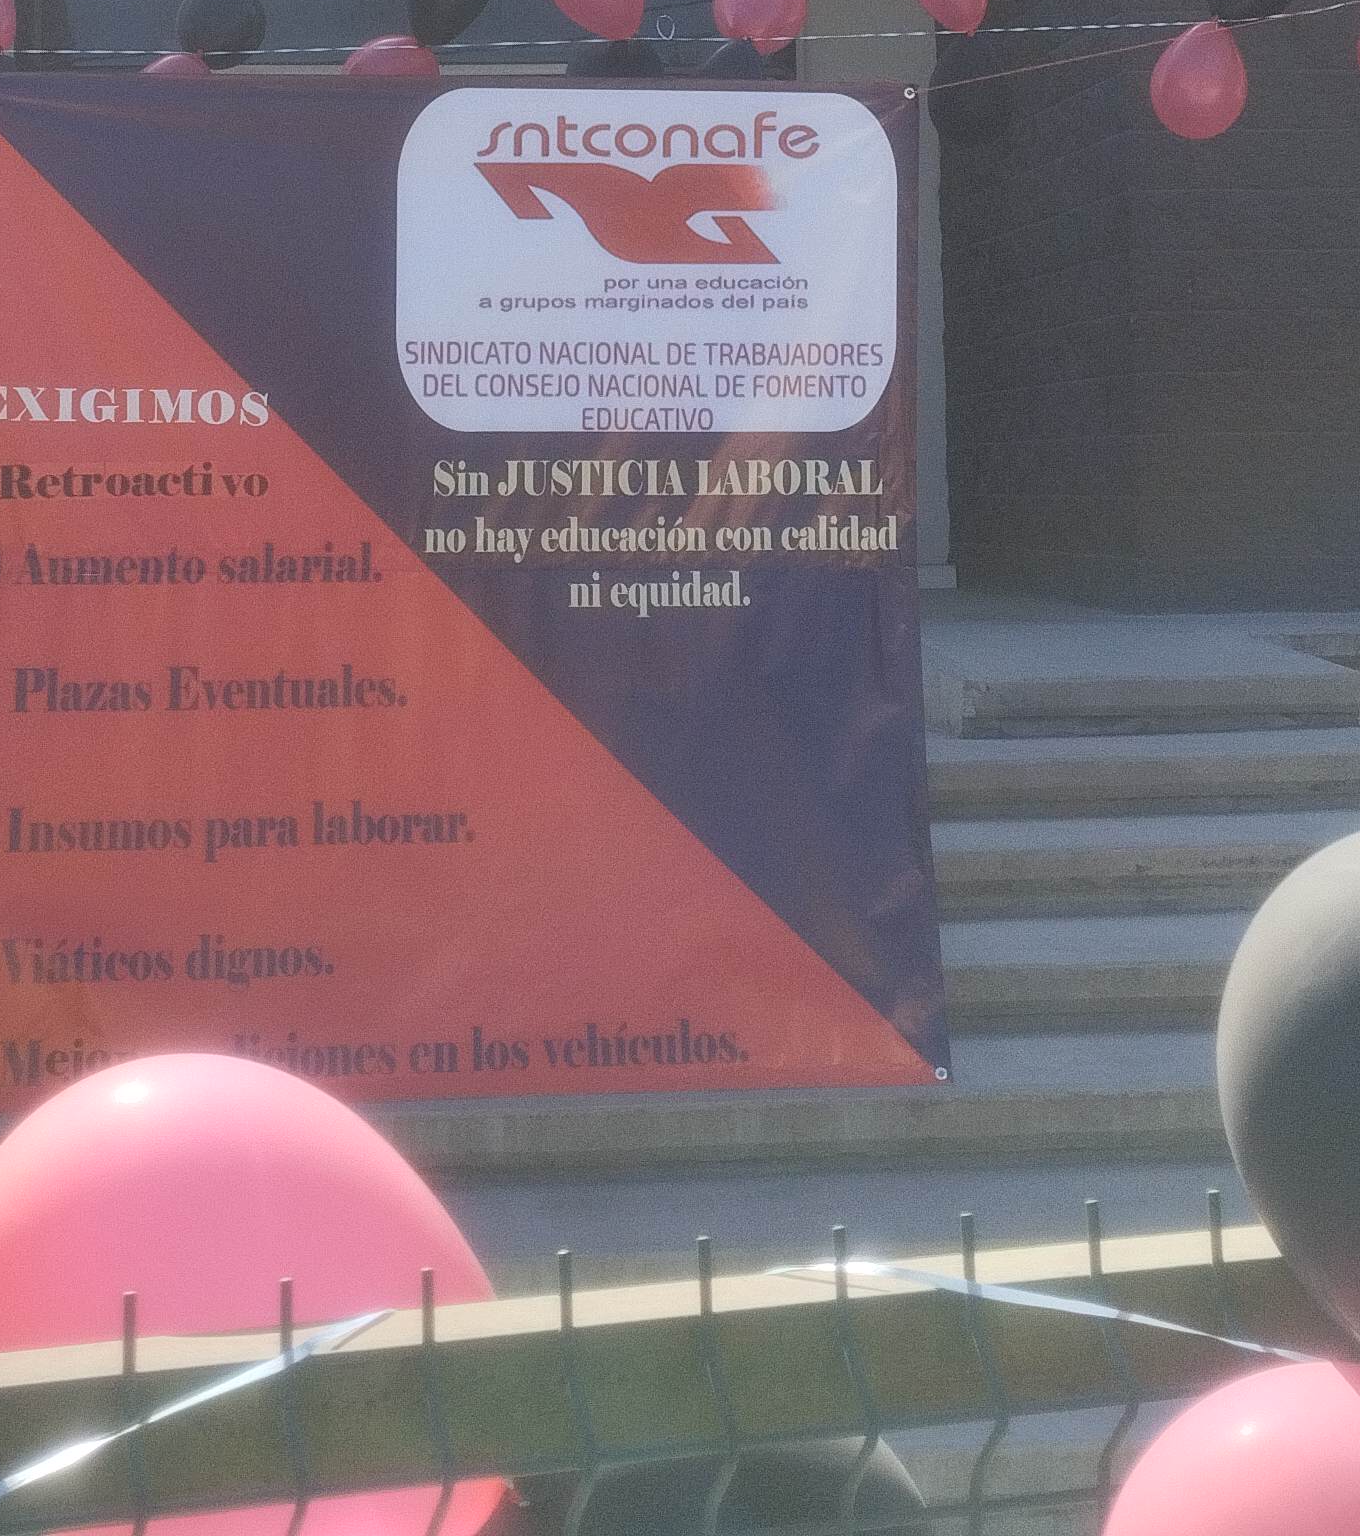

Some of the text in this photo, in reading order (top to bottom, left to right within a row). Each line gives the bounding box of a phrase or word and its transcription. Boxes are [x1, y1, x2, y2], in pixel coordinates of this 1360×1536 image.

[477, 110, 821, 159] sntconafe
[478, 293, 809, 313] a grupos marginados del país
[603, 274, 809, 293] por una educación
[405, 341, 884, 367] SINDICATO NACIONAL DE TRABAJADORES
[422, 373, 866, 399] DEL CONSEJO NACIONAL DE FOMENTO
[581, 407, 714, 432] EDUCATIVO
[433, 459, 883, 498] Sin JUSTICIA LABORAL
[425, 514, 899, 564] no hay educación con calidad
[13, 541, 383, 586] Aumento salarial.
[568, 570, 752, 617] ni equidad.
[9, 663, 408, 713] Plazas Eventuales.
[4, 800, 475, 863] Insumos para laborar.
[0, 932, 335, 991] Viáticos dignos.
[409, 1038, 460, 1073] en
[471, 1024, 531, 1072] los
[543, 1017, 750, 1068] vehículos.
